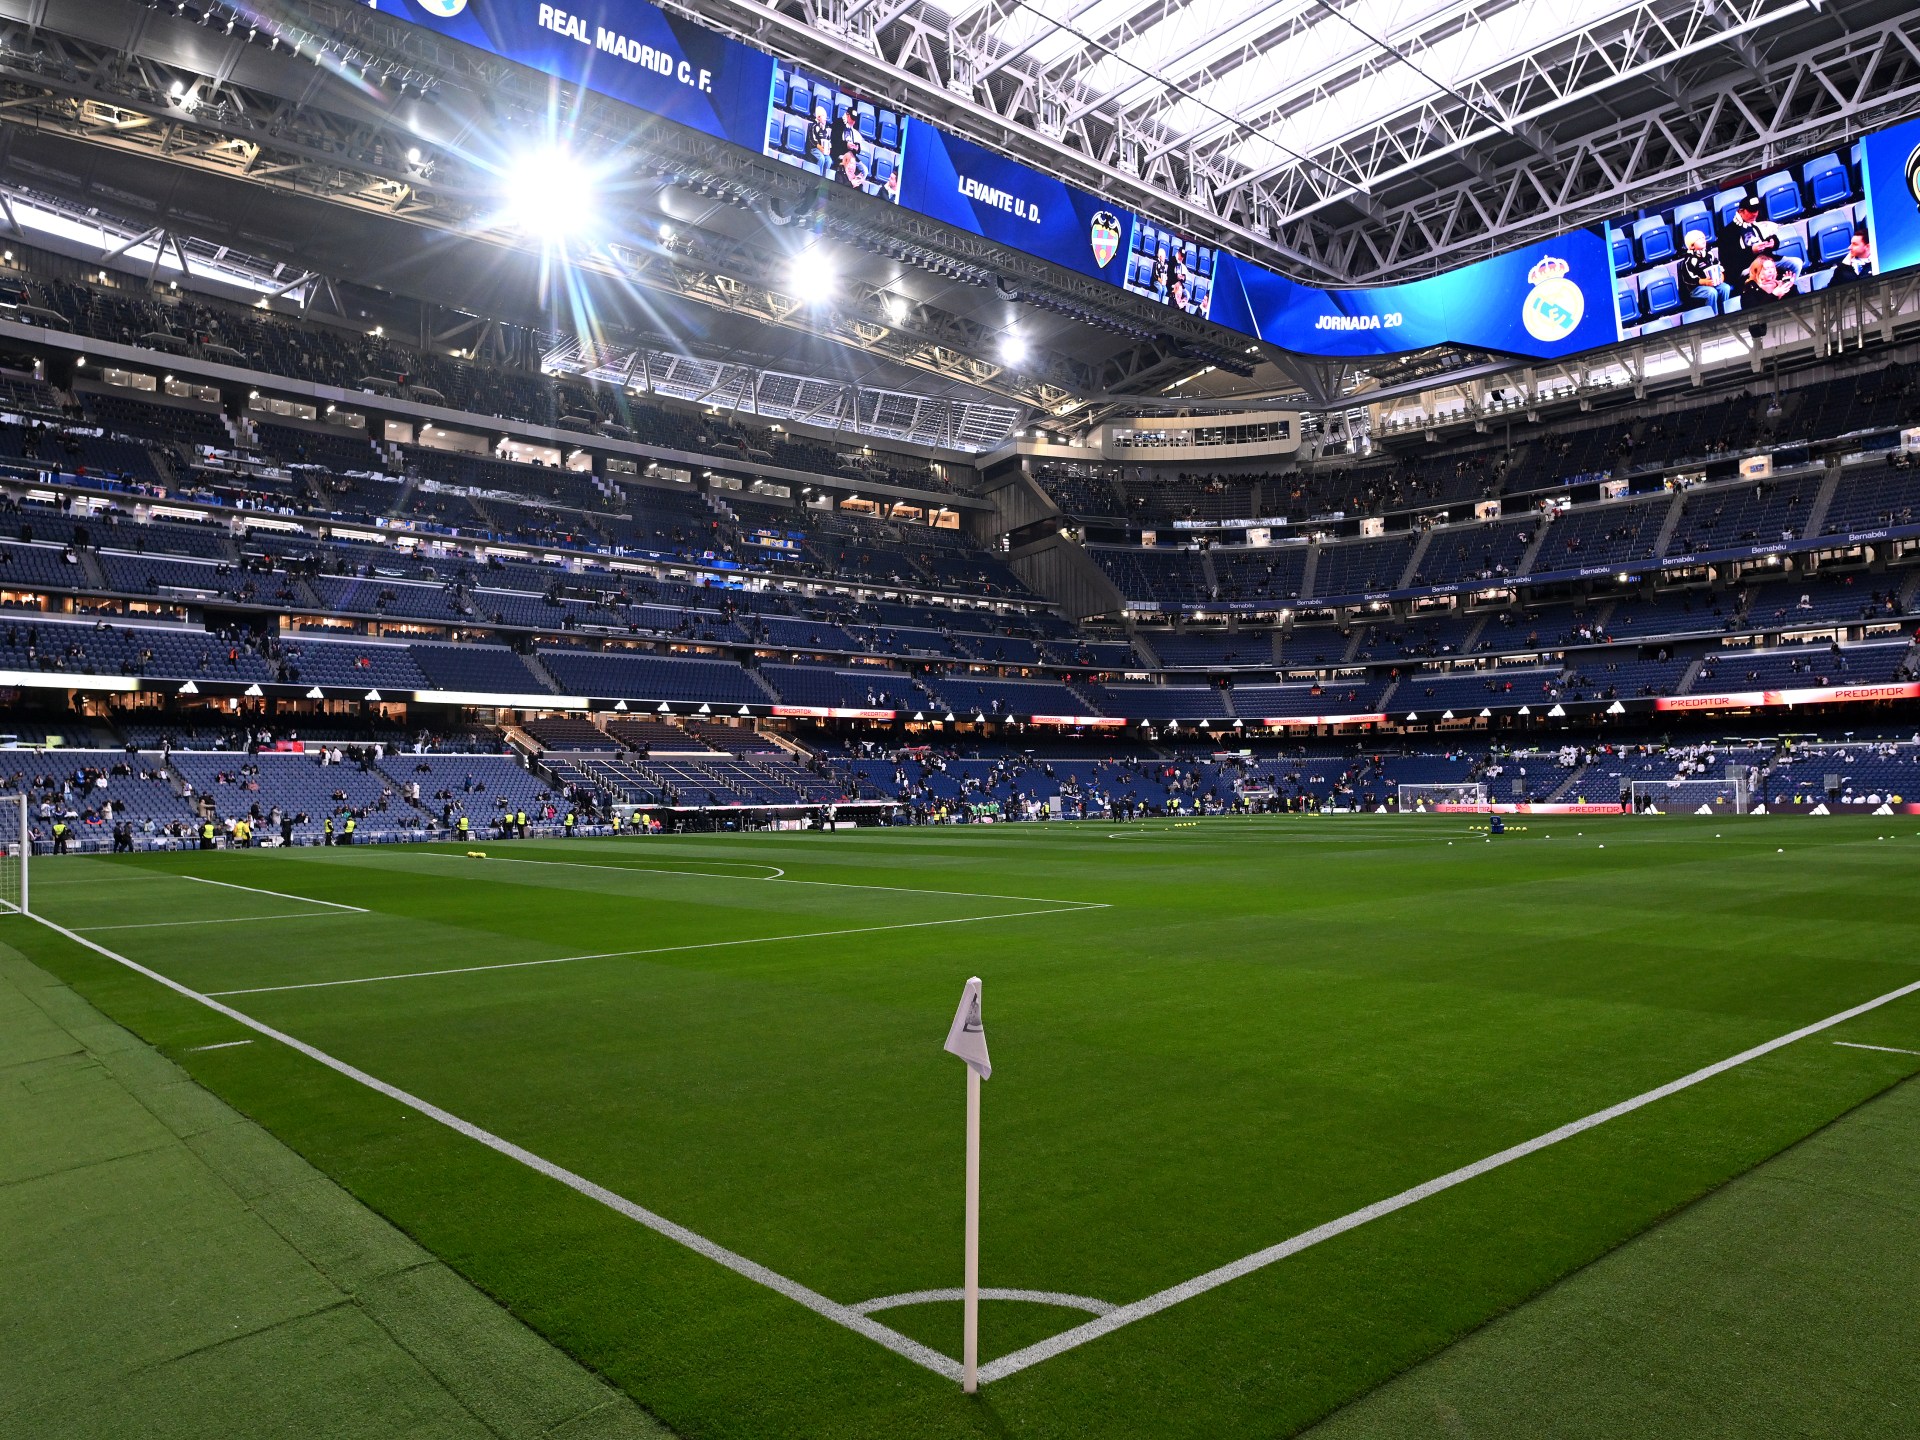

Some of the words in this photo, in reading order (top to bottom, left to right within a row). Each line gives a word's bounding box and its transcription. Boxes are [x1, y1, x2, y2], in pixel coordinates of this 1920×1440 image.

[538, 3, 591, 45] REAL
[596, 26, 673, 76] MADRID
[677, 61, 695, 86] C.
[698, 69, 712, 93] F.
[958, 175, 1013, 213] LEVANTE
[1014, 198, 1027, 219] U.
[1029, 203, 1041, 224] D.
[1315, 315, 1381, 330] JORNADA
[1383, 312, 1403, 328] 20
[1848, 530, 1887, 542] Bernabéu
[1751, 544, 1787, 554] Bernabéu
[1662, 555, 1695, 565] Bernabéu
[1580, 566, 1610, 576] Bernabéu
[1503, 576, 1532, 585] Bernabéu
[1431, 585, 1459, 593] Bernabéu
[1364, 592, 1390, 600] Bernabéu
[1835, 687, 1904, 698] PREDATOR
[1670, 697, 1730, 707] PREDATOR
